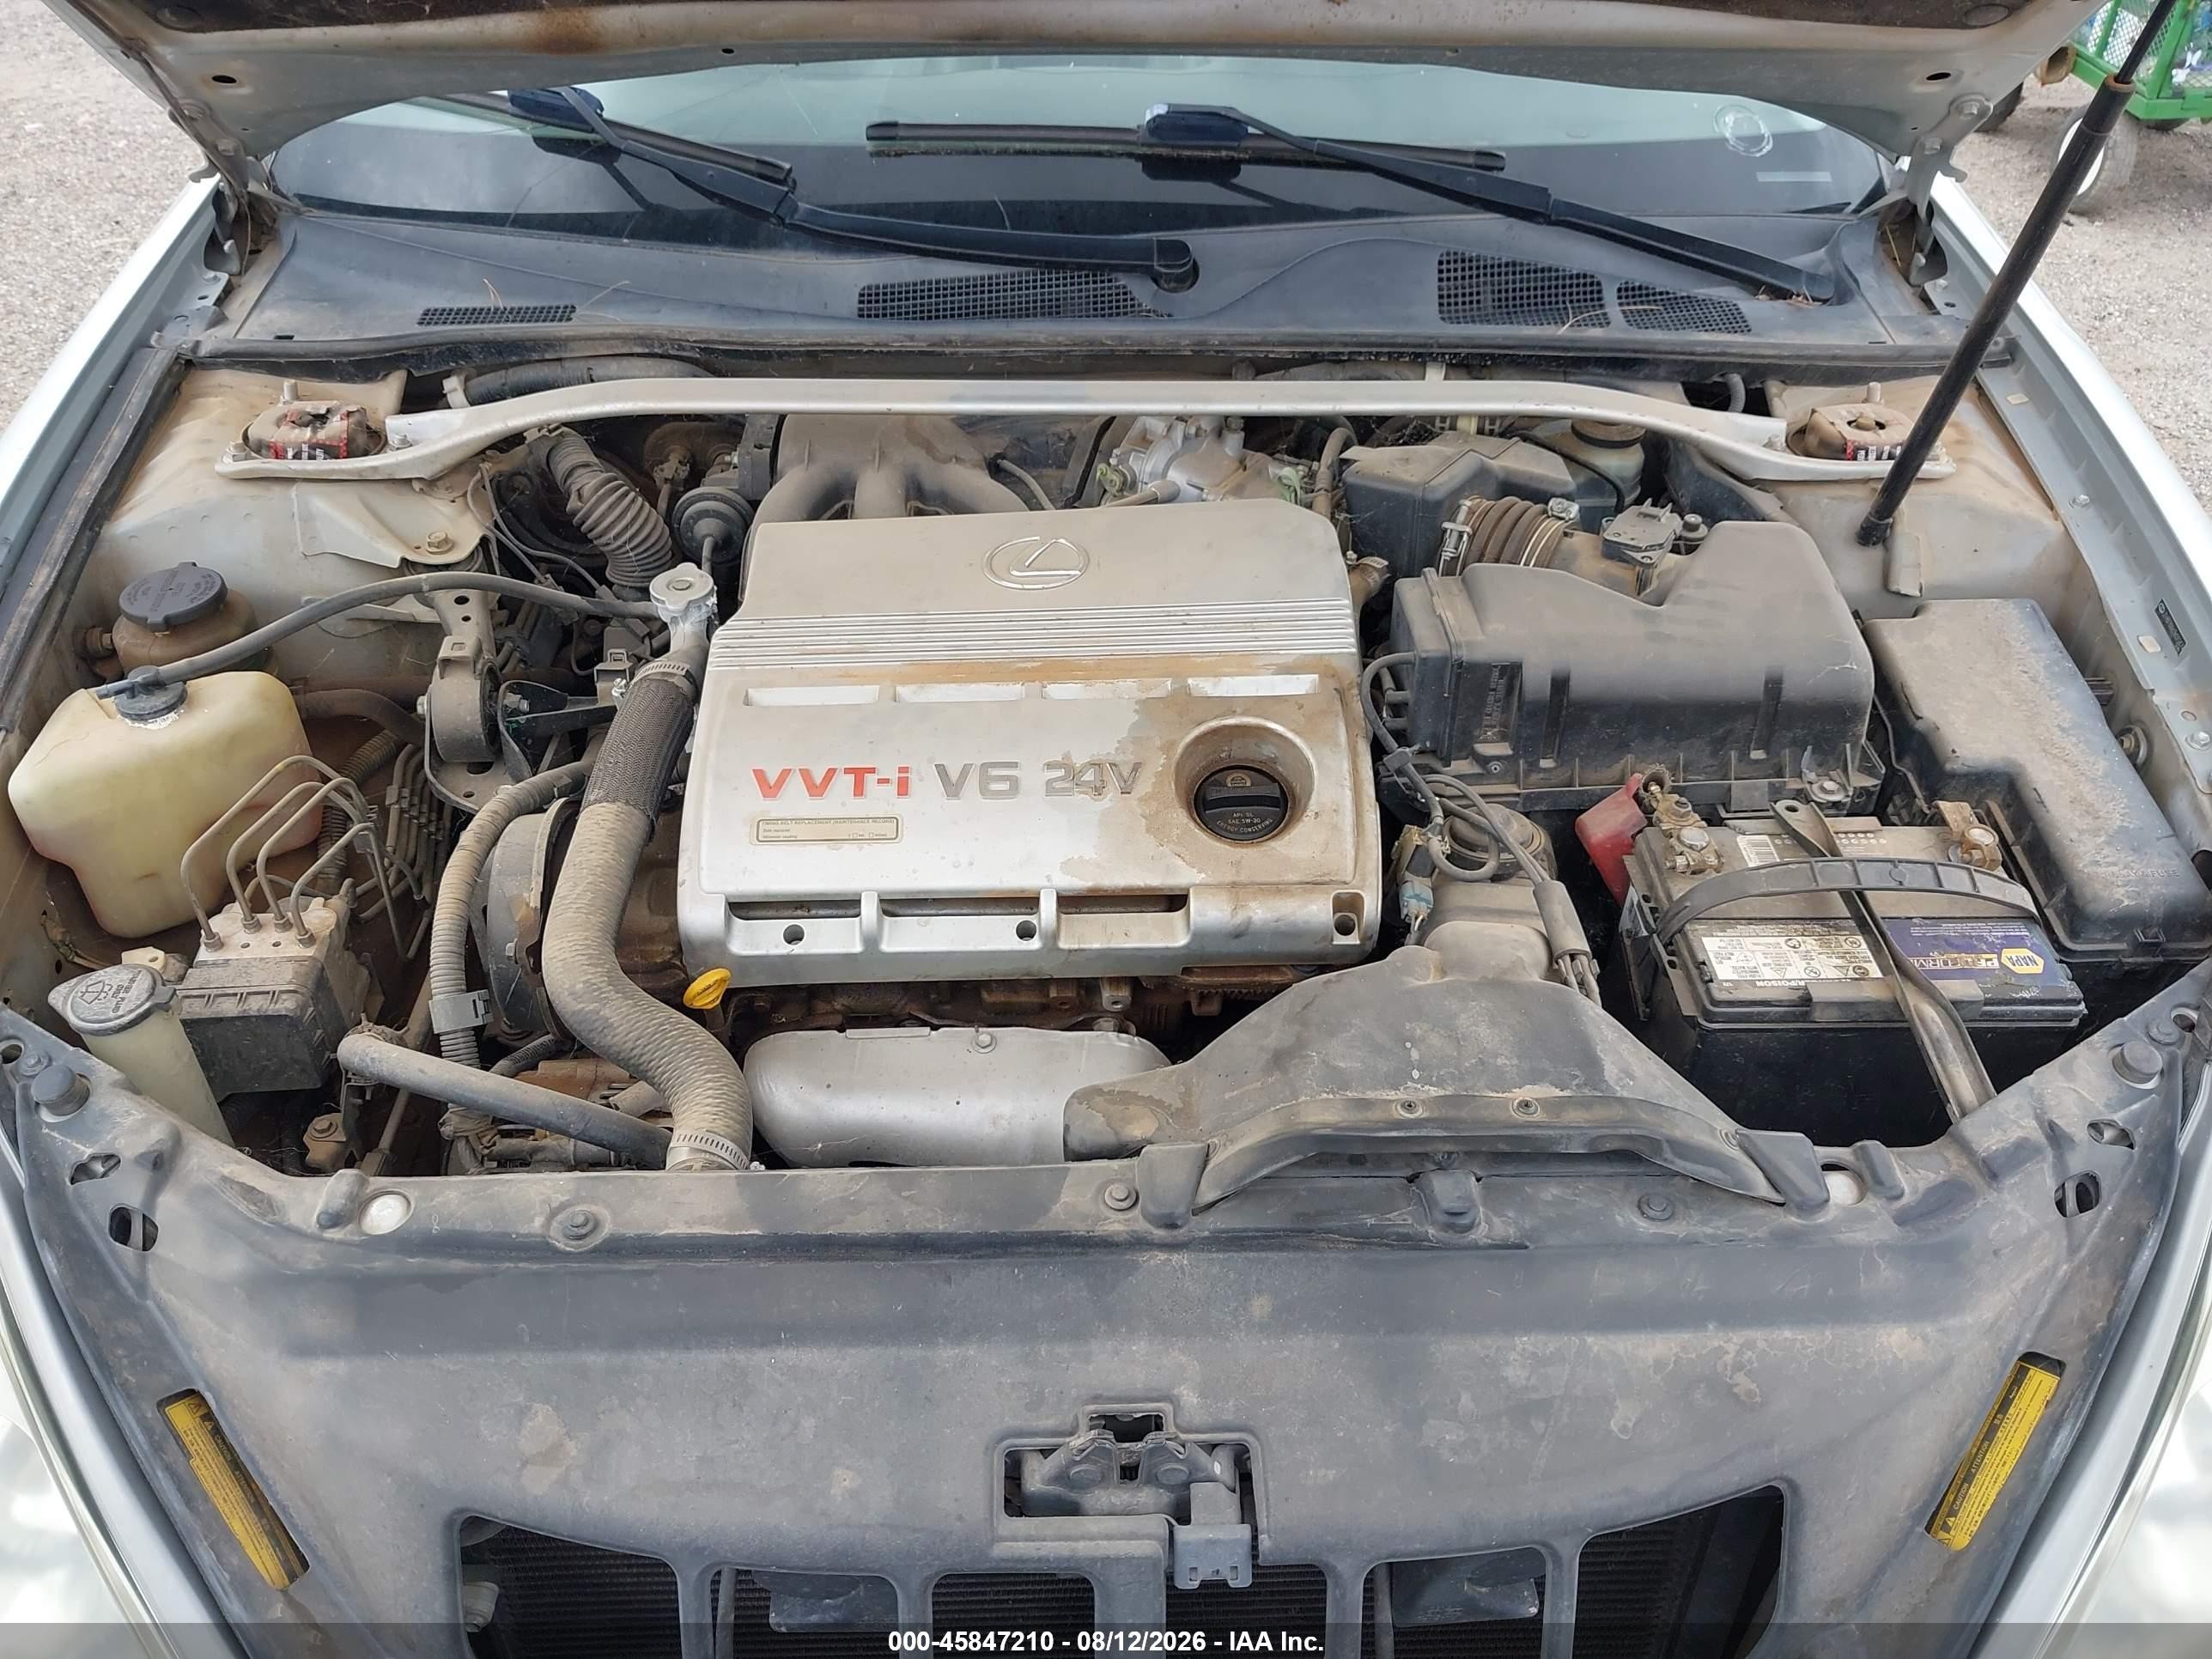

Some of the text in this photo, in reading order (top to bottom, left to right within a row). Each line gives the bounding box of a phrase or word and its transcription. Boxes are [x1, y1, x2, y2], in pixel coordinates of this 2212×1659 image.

[751, 760, 1143, 800] VVT-i V6 24V
[1217, 818, 1273, 832] ENERGY CONSERVING
[2005, 955, 2039, 967] NAPA
[213, 1434, 233, 1462] CAUTION
[234, 1469, 256, 1504] ATTENTION
[1953, 1482, 1969, 1510] CAUTION
[1970, 1439, 1990, 1474] ATTENTION
